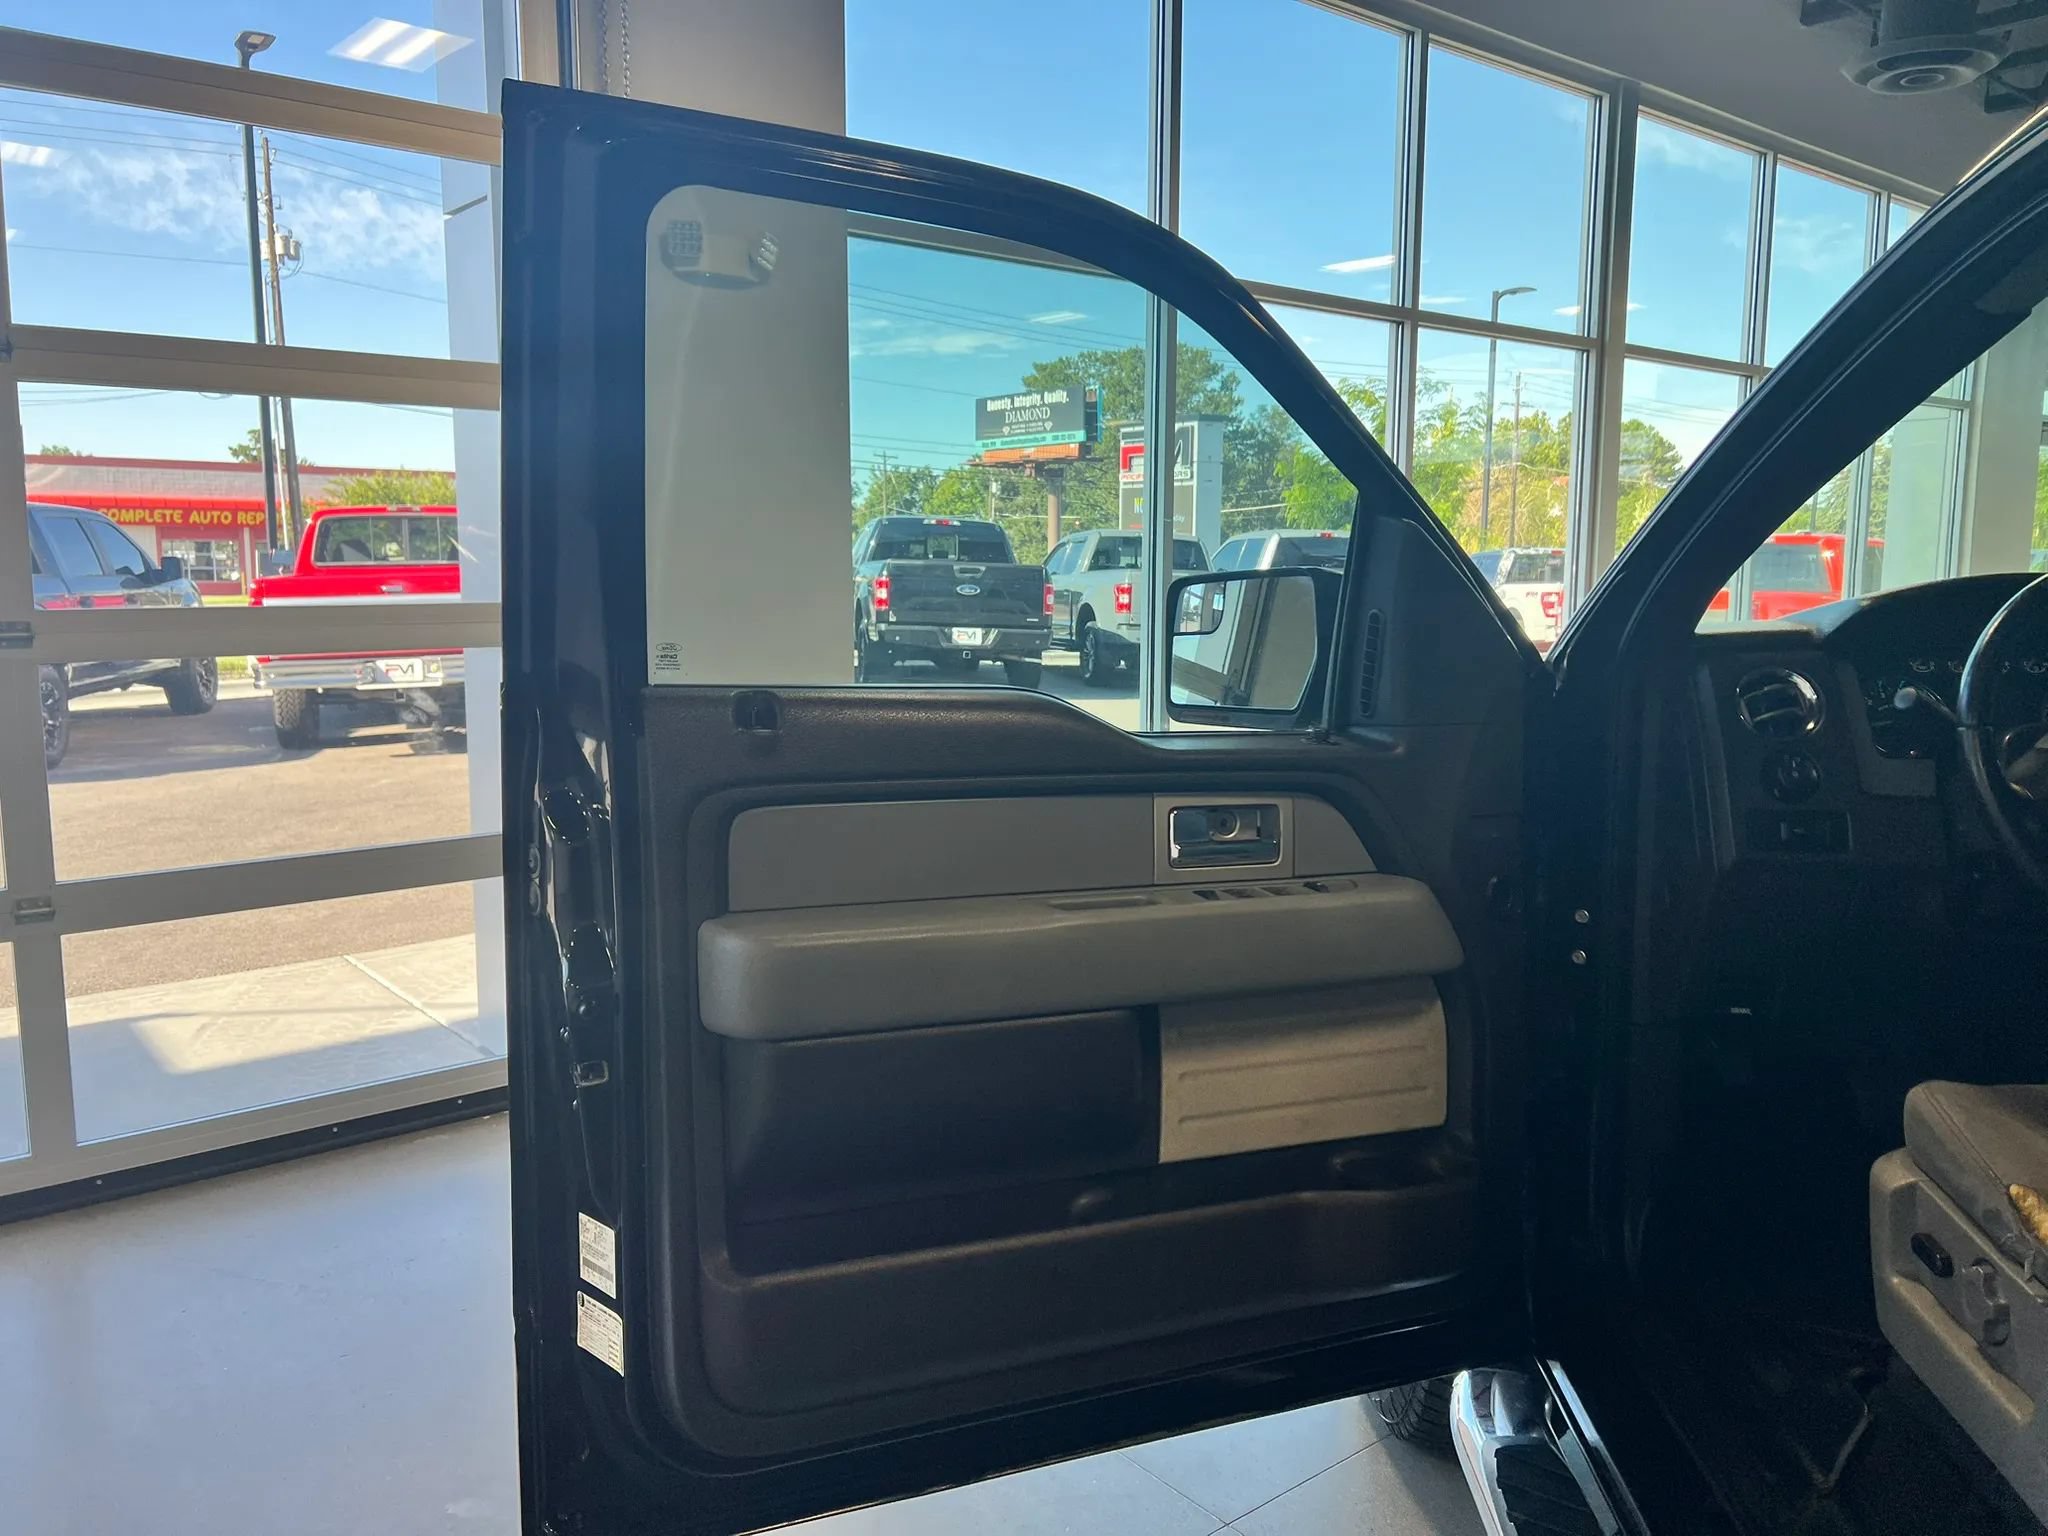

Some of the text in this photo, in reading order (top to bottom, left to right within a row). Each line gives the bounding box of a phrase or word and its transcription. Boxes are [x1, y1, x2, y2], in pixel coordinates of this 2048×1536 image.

[1044, 389, 1070, 404] Quality.
[1005, 407, 1051, 424] DIAMOND
[189, 511, 233, 525] AUTO
